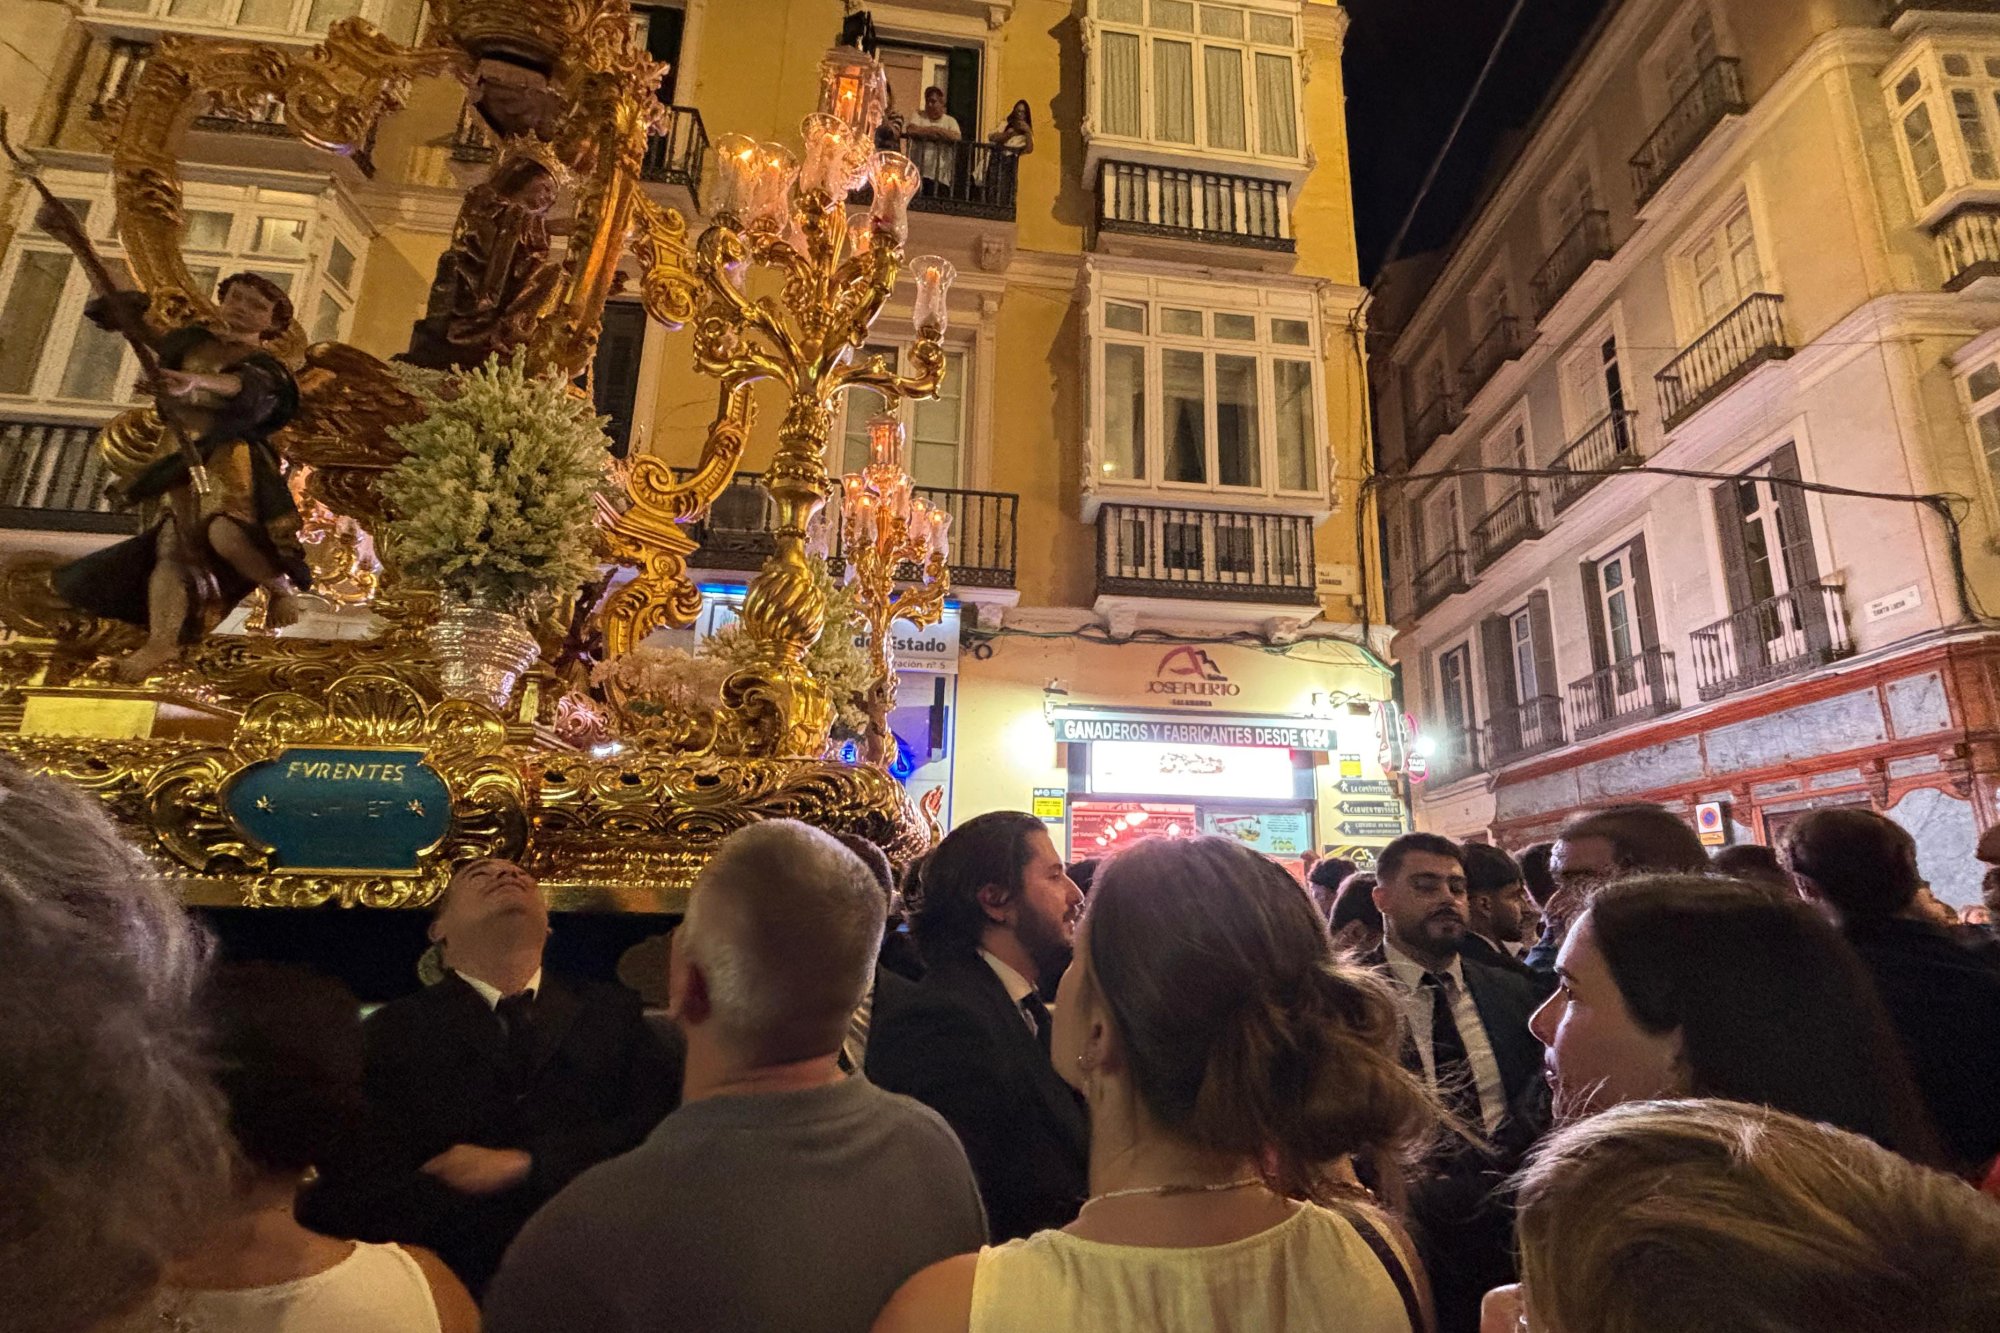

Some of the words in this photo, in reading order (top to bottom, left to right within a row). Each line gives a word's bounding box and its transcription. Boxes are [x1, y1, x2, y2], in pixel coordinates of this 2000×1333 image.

[1064, 720, 1148, 741] GANADEROS
[1150, 724, 1161, 741] Y
[1163, 724, 1253, 745] FABRICANTES
[1255, 727, 1299, 747] DESDE
